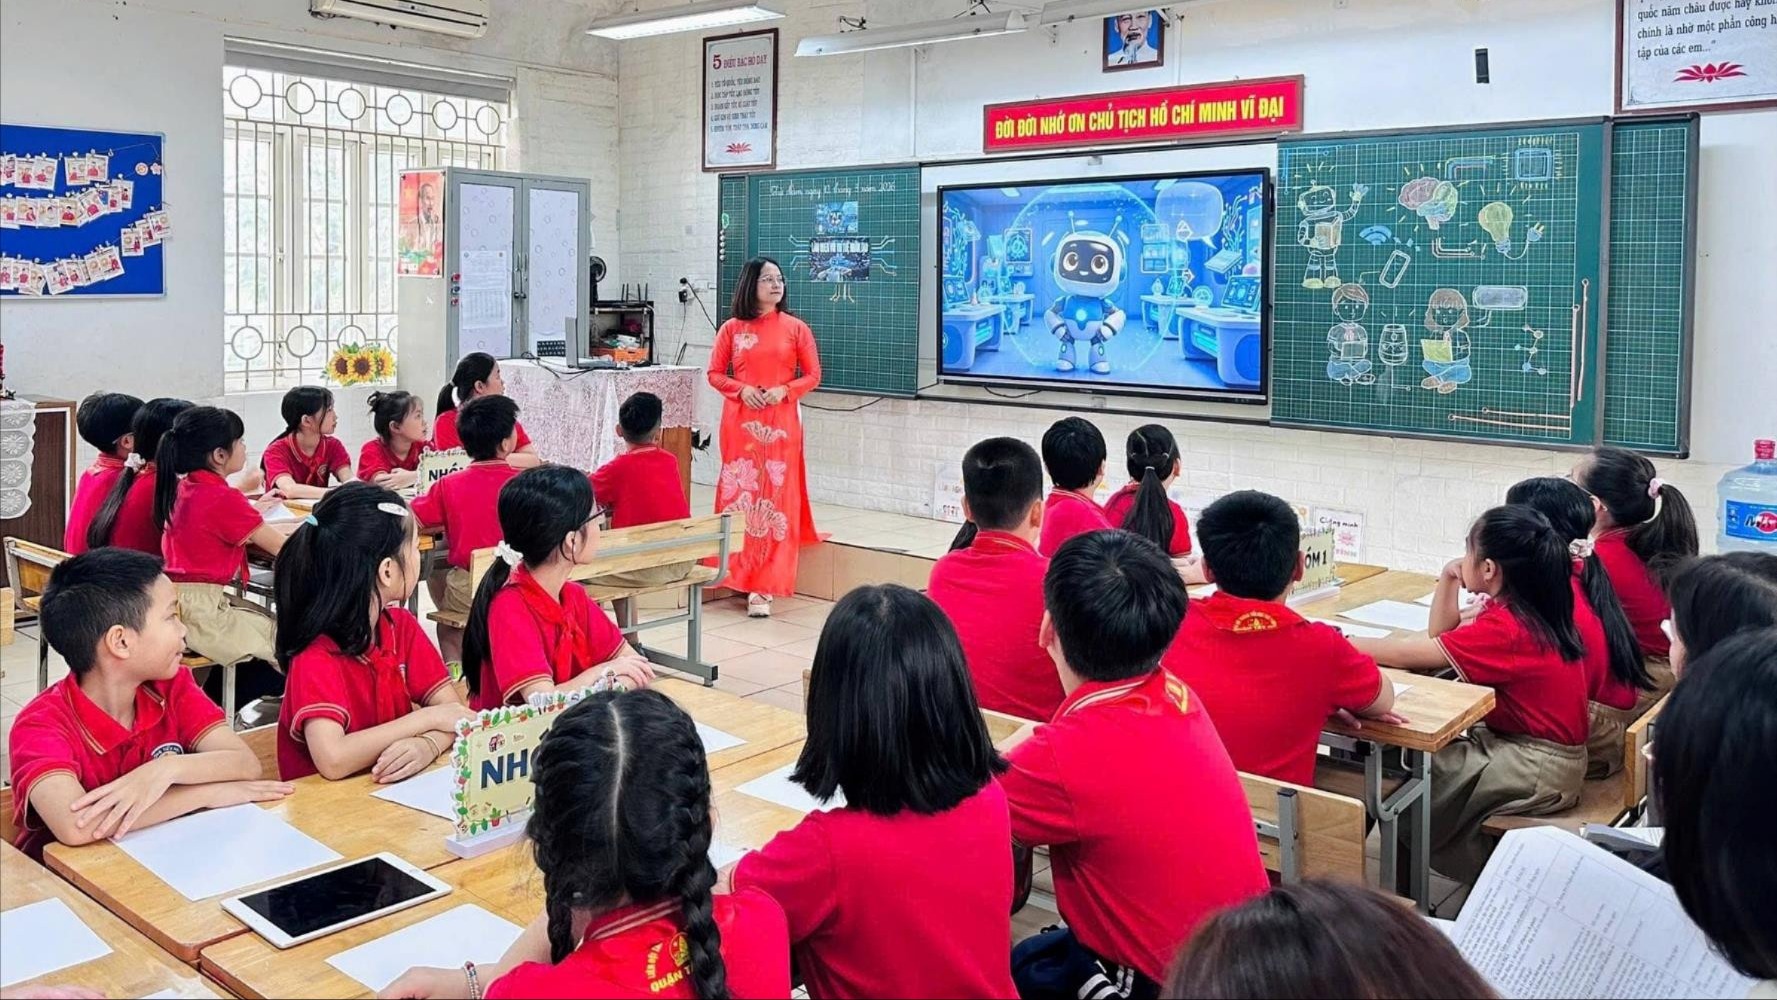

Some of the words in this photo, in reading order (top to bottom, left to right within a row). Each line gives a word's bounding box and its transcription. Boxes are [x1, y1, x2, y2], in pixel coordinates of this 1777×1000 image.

[1637, 4, 1658, 22] quốc
[1661, 6, 1681, 17] năm
[1637, 27, 1662, 39] chính
[1665, 25, 1673, 36] là
[1676, 22, 1694, 34] nhờ
[1697, 19, 1715, 34] một
[1718, 14, 1742, 33] phần
[1745, 15, 1767, 29] công
[713, 54, 722, 70] 5
[1637, 45, 1652, 61] tập
[1654, 44, 1669, 57] của
[1672, 42, 1686, 55] các
[995, 115, 1015, 139] ĐỜI
[1017, 113, 1037, 137] ĐỜI
[1040, 109, 1066, 135] NHỚ
[1068, 112, 1086, 132] ƠN
[1089, 102, 1114, 132] CHỦ
[1117, 107, 1147, 133] TỊCH
[1150, 99, 1169, 127] HỒ
[1172, 99, 1195, 125] CHÍ
[1199, 100, 1237, 123] MINH
[1241, 94, 1257, 120] VĨ
[1258, 96, 1285, 123] ĐẠI
[428, 462, 465, 481] NHÓ
[1304, 546, 1321, 569] ÓM
[1322, 549, 1327, 565] 1
[481, 747, 529, 790] NH
